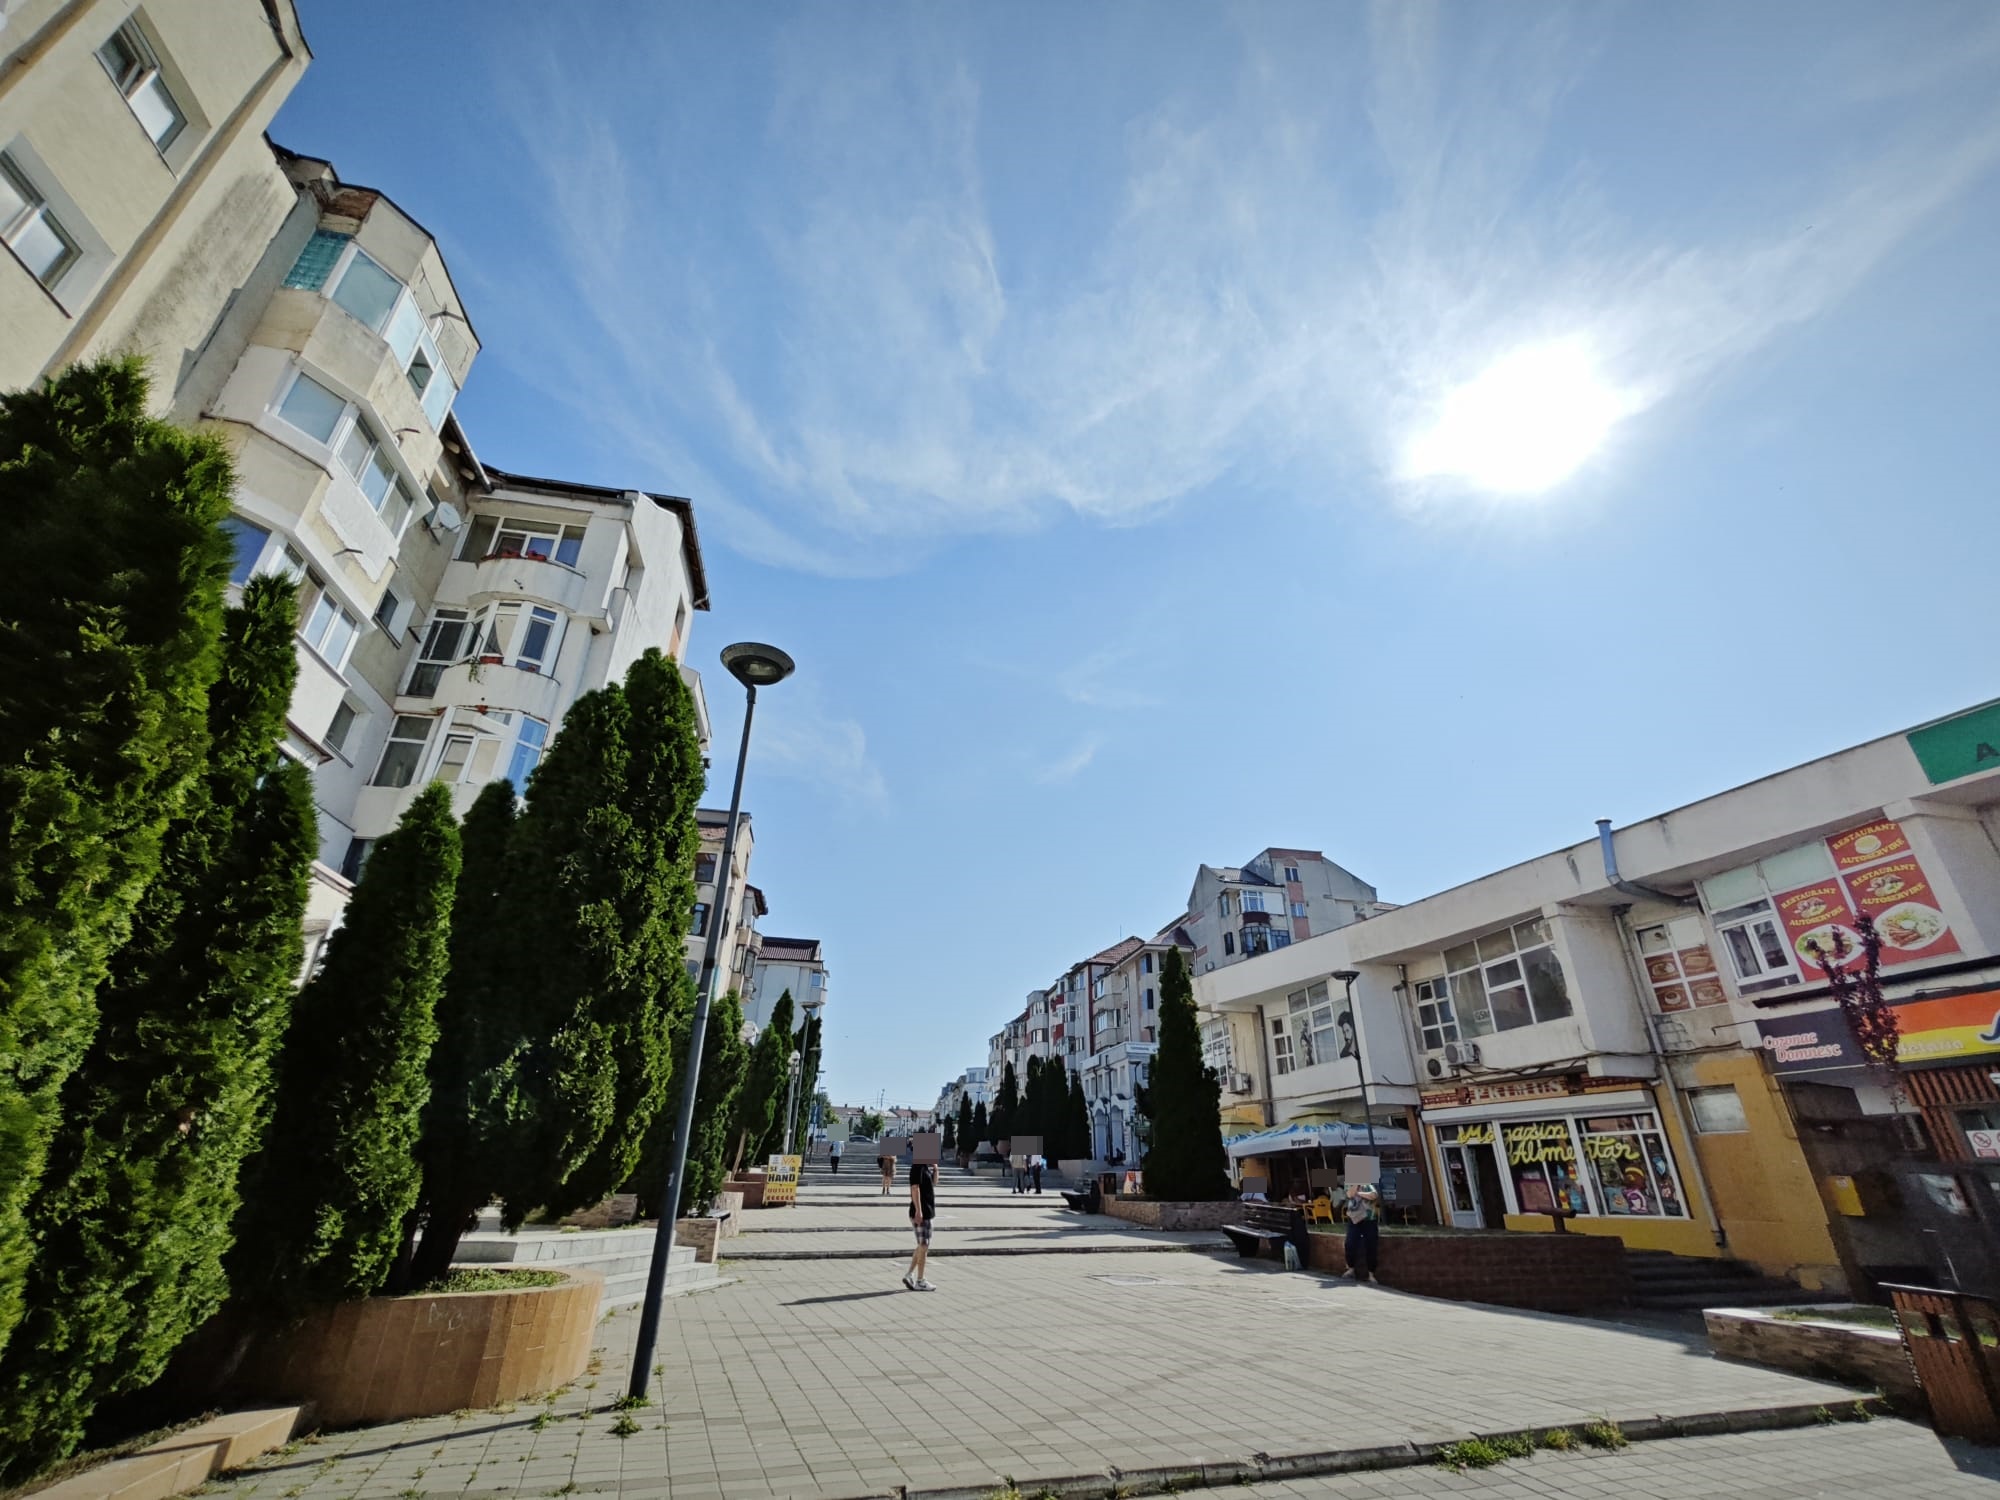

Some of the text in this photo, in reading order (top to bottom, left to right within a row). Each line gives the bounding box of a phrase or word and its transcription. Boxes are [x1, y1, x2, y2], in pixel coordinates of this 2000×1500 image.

[1832, 823, 1897, 850] RESTAURANT
[1840, 838, 1905, 864] AUTOSERVIRE
[1851, 863, 1916, 887] RESTAURANT
[1781, 887, 1836, 909] RESTAURANT
[1861, 882, 1926, 905] AUTOSERVIRE
[1789, 905, 1845, 926] AUTOSERVIRE
[1763, 1032, 1818, 1049] Cozonac
[1775, 1043, 1842, 1063] Domnesc
[1474, 1079, 1564, 1100] PRIMUS
[768, 1174, 795, 1182] HAND
